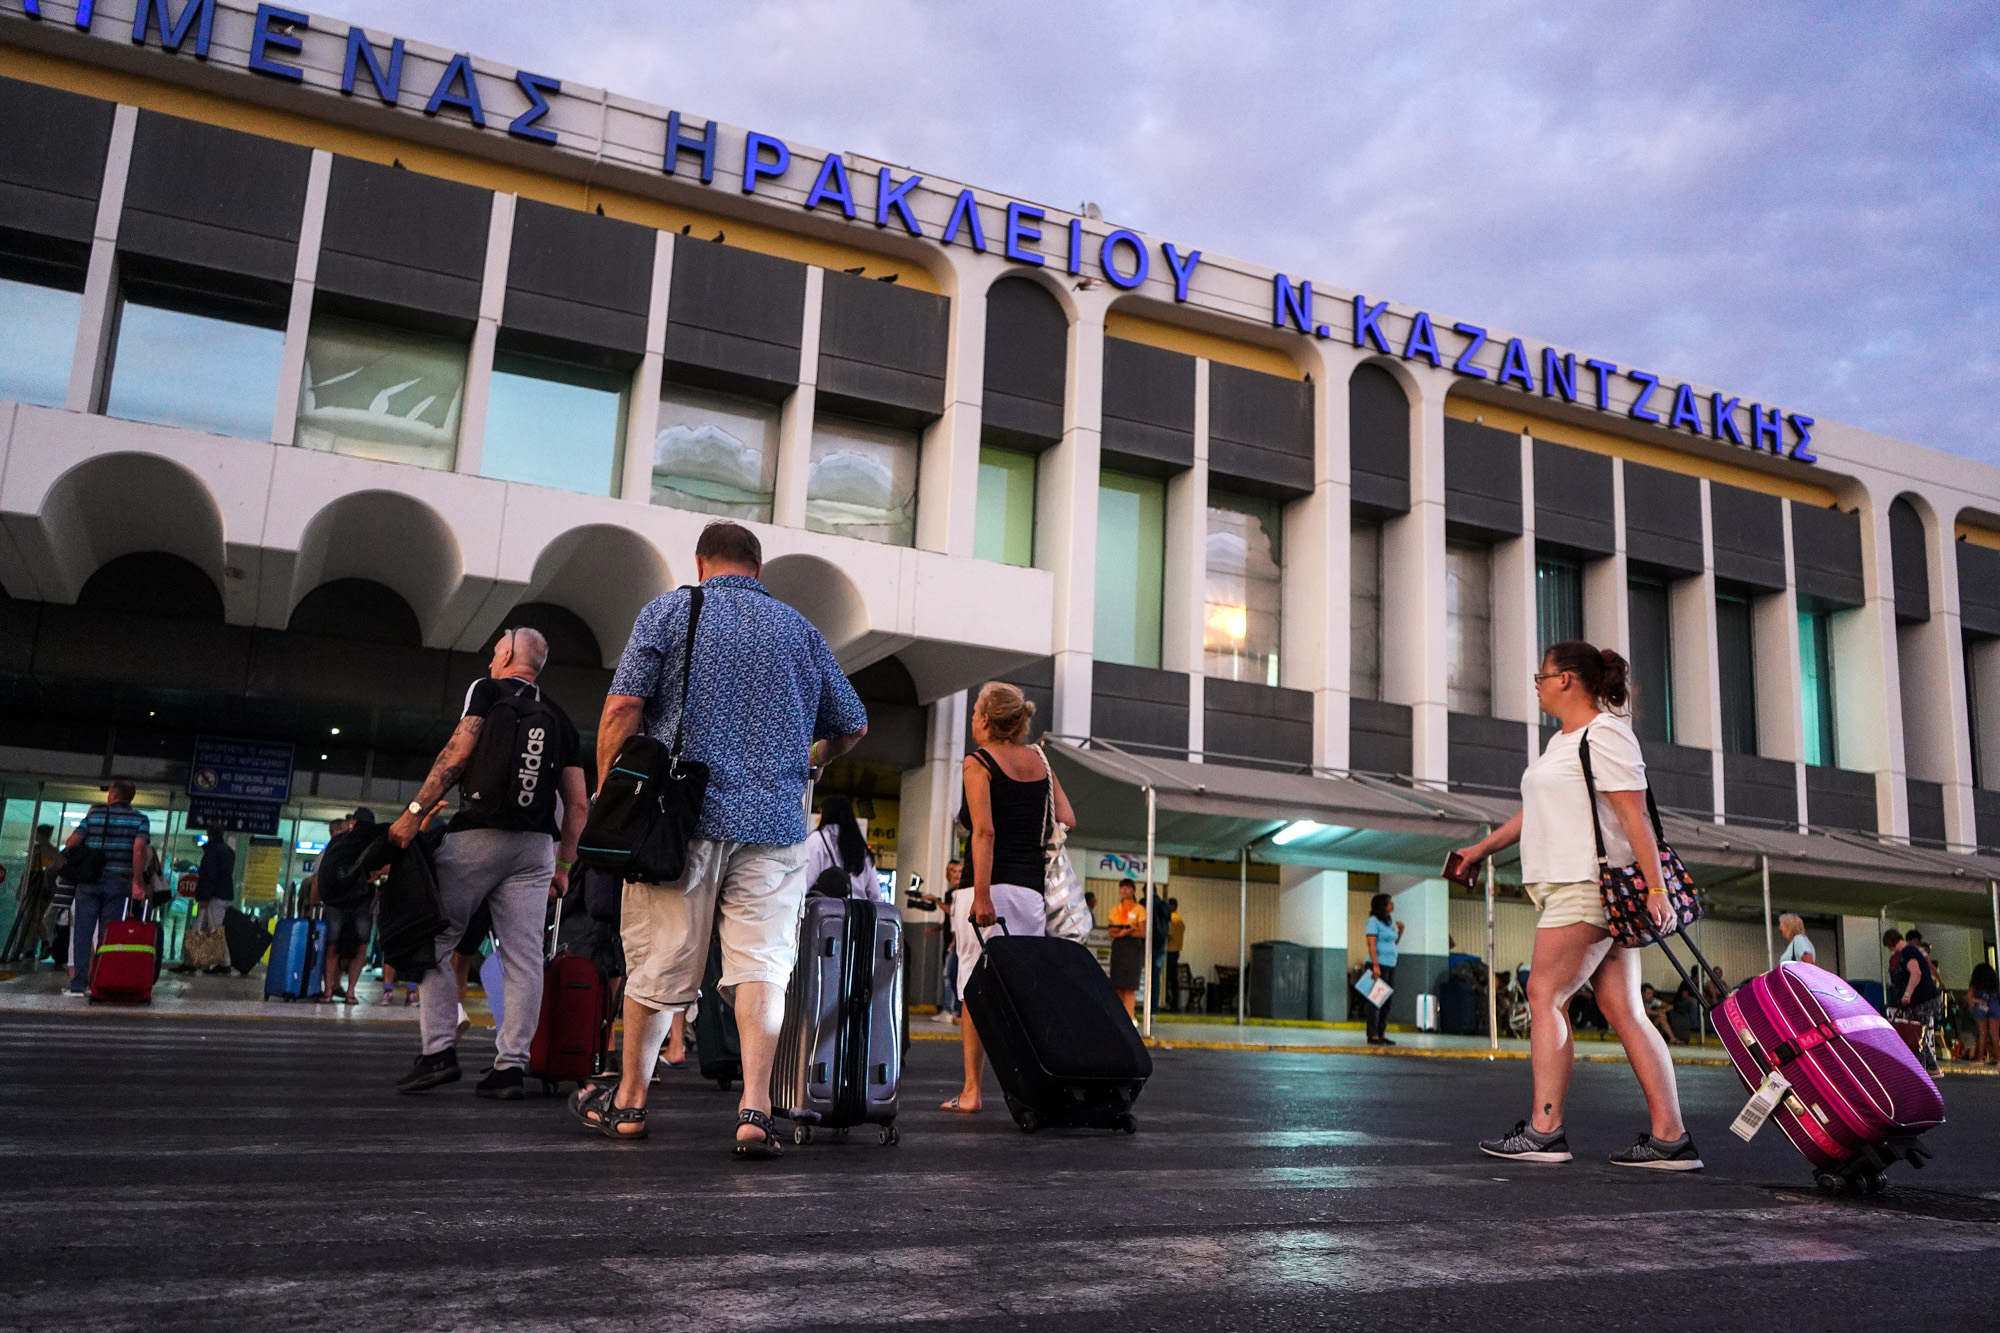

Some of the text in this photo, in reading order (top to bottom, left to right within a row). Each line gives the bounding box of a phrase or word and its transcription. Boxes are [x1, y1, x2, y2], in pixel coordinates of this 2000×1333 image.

[20, 0, 562, 145] ΜΕΝΑΣ
[662, 110, 1202, 302] ΗΡΑΚΛΕΙΟΥ
[517, 727, 545, 807] adidas
[179, 880, 197, 892] STO
